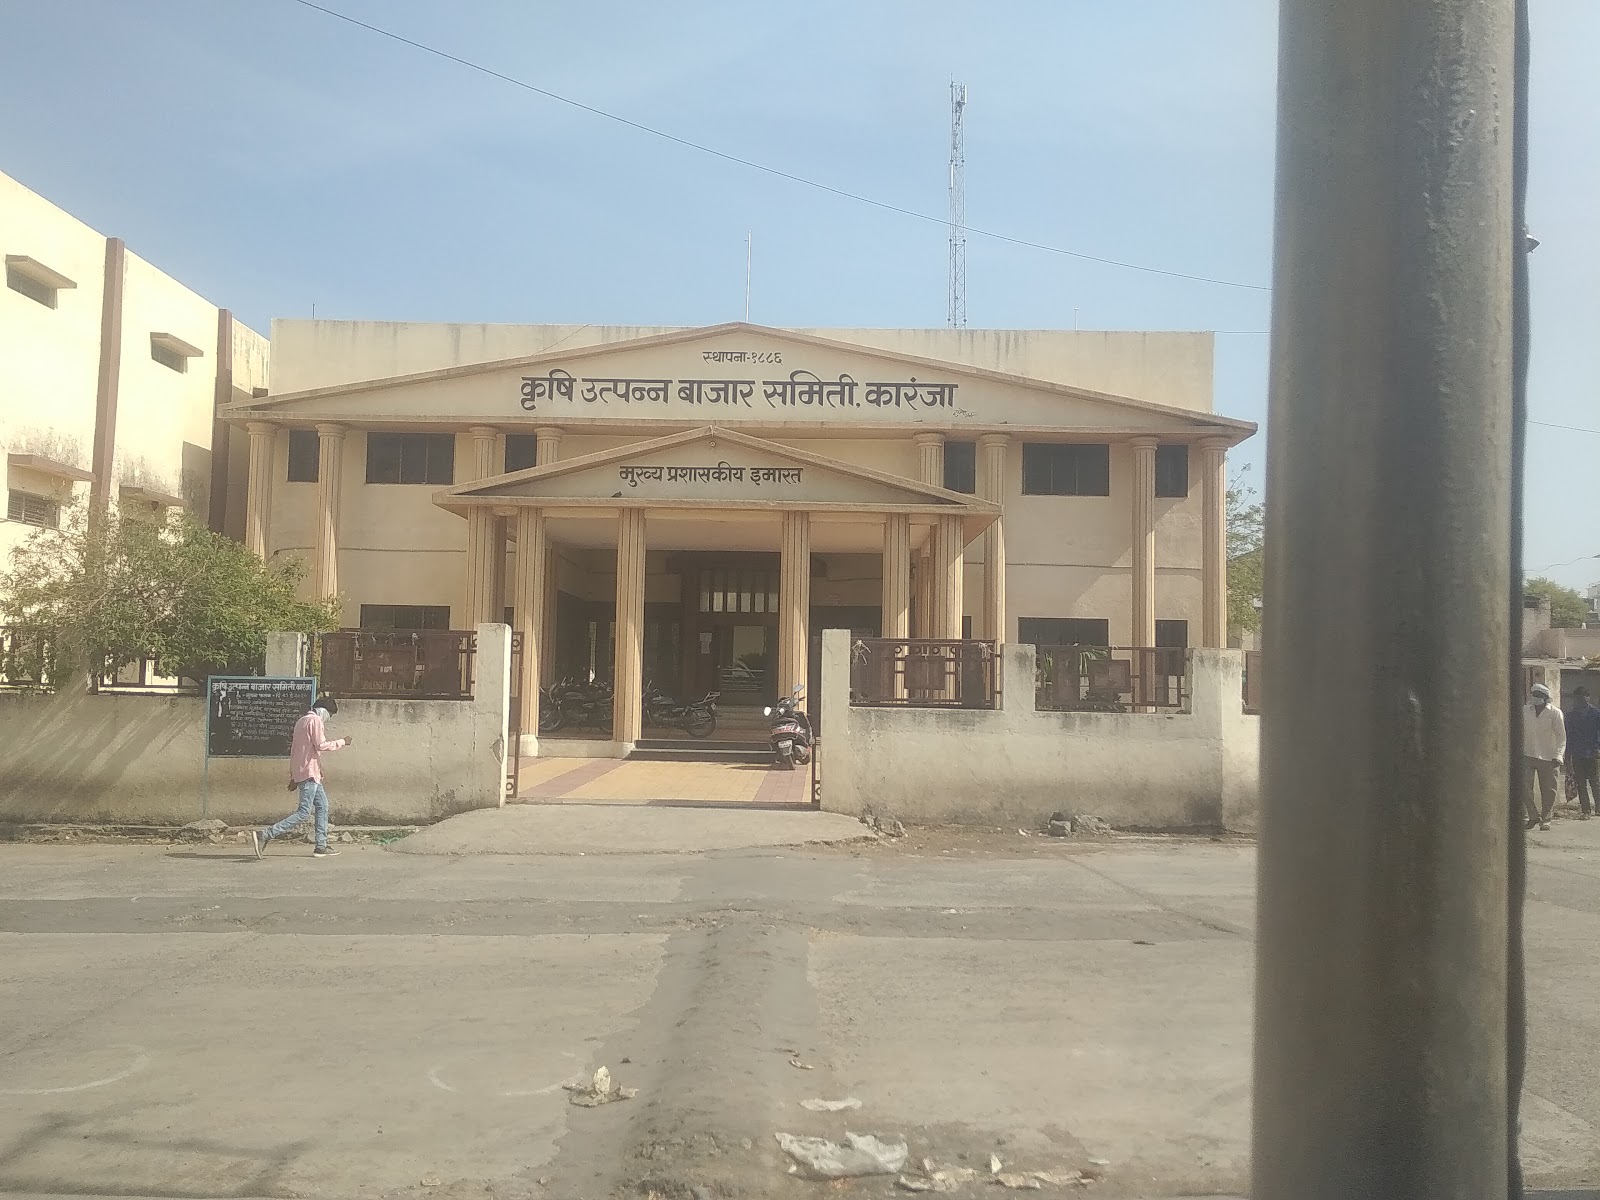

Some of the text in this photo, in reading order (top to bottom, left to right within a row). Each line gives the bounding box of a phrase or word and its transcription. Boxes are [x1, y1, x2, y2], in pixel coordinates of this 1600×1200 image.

[702, 351, 783, 366] स्थापना-१८८६
[520, 368, 577, 410] कृषि
[581, 378, 673, 404] उत्पन्न
[678, 379, 756, 408] बाजार
[865, 376, 959, 411] कारंजा
[619, 461, 804, 488] मुख्य प्रशासकीय इमारत
[212, 680, 227, 693] कृषि
[251, 682, 271, 691] बाजार
